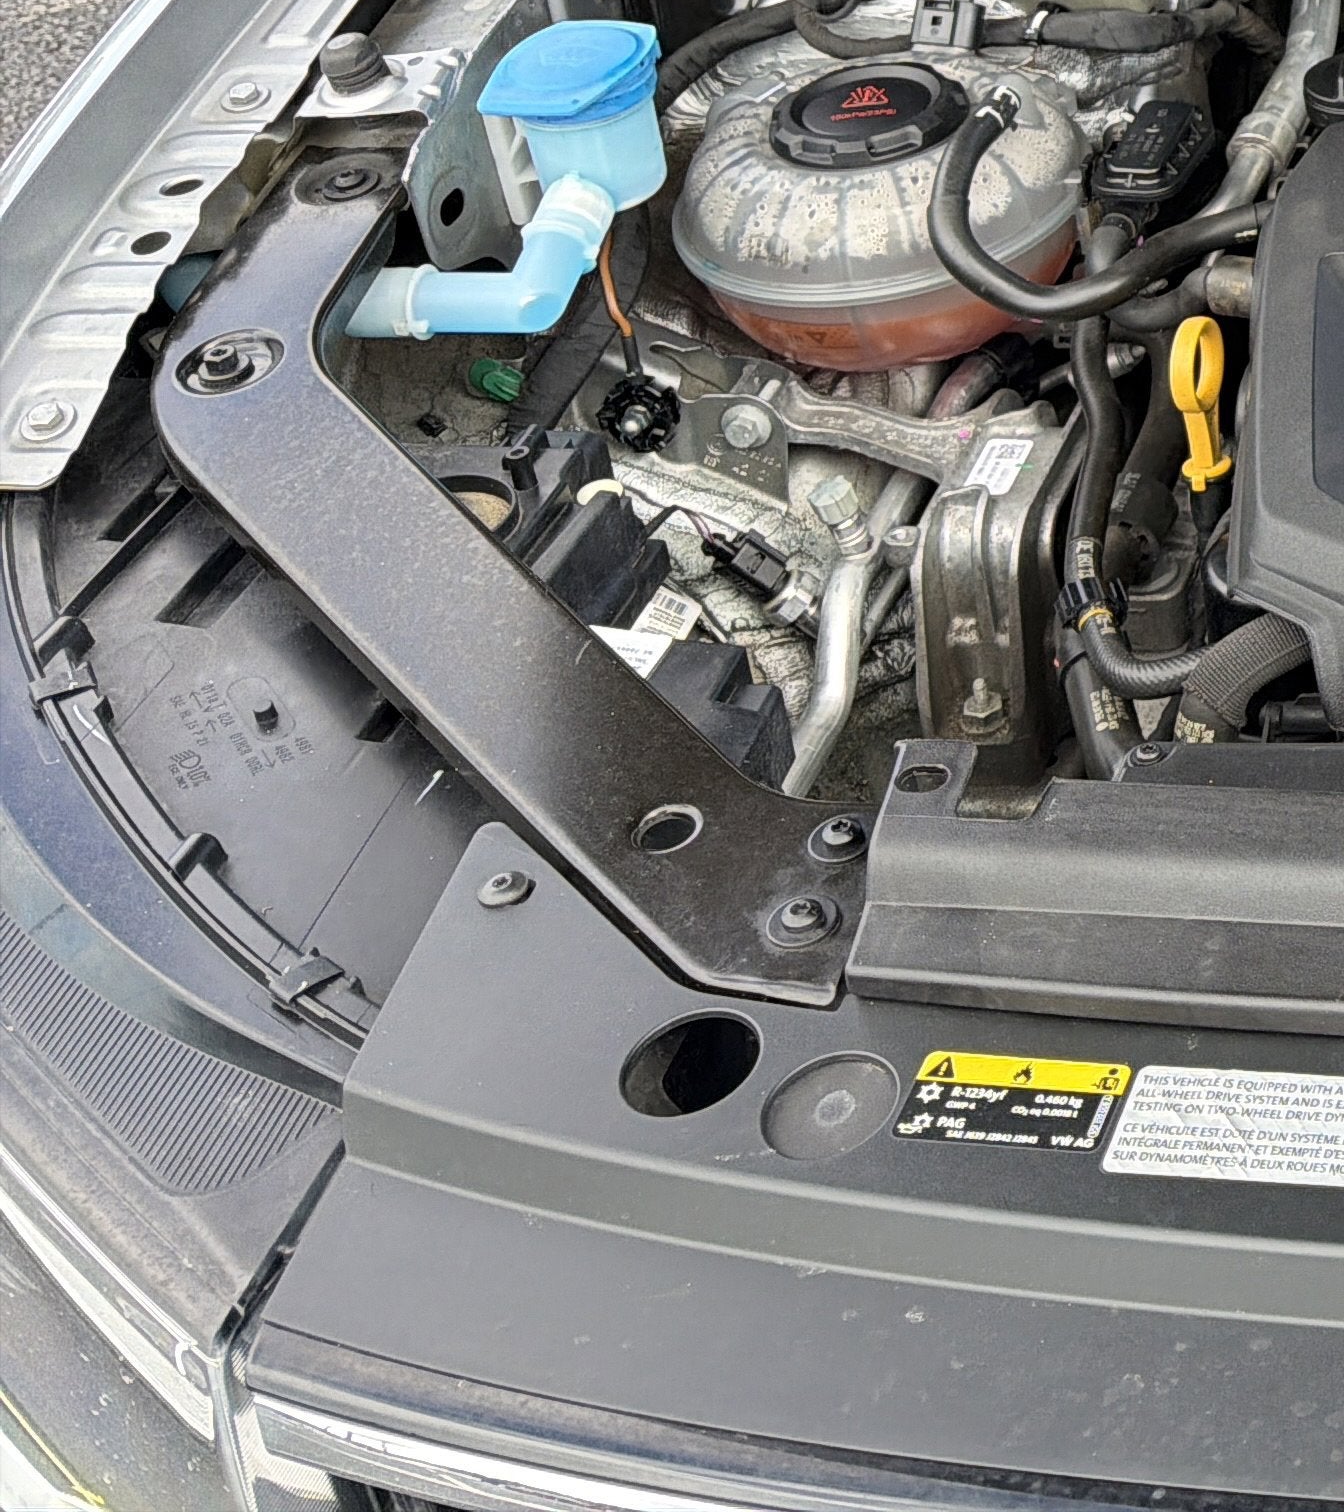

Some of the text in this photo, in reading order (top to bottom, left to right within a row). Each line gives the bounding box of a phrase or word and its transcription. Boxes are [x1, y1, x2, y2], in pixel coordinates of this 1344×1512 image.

[1143, 1074, 1169, 1086] THIS
[1172, 1076, 1220, 1089] VEHICLE
[1223, 1079, 1234, 1090] IS
[1237, 1079, 1299, 1093] EQUIPPED
[1301, 1083, 1332, 1095] WITH
[1334, 1085, 1344, 1096] A
[950, 1087, 1009, 1103] R-1234yf
[1069, 1096, 1084, 1109] kg
[1136, 1088, 1202, 1102] ALL-WHEEL
[1206, 1092, 1244, 1105] DRIVE
[1245, 1094, 1288, 1107] SYSTEM
[1296, 1097, 1320, 1109] AND
[1323, 1098, 1332, 1109] IS
[936, 1116, 966, 1128] PAG
[1133, 1101, 1182, 1114] TESTING
[1184, 1104, 1204, 1116] ON
[1208, 1105, 1283, 1120] TWO-WHEEL
[1286, 1110, 1322, 1122] DRIVE
[1050, 1136, 1094, 1148] VW AG
[1123, 1122, 1141, 1134] CE
[1143, 1121, 1198, 1137] VÉHICULE
[1200, 1127, 1220, 1139] EST
[1223, 1126, 1254, 1141] DOTÉ
[1257, 1130, 1288, 1143] D'UN
[1290, 1130, 1344, 1146] SYSTÈME
[1117, 1134, 1180, 1151] INTÉGRALE
[1270, 1143, 1322, 1159] EXEMPTÉ
[1111, 1150, 1137, 1162] SUR
[1138, 1149, 1237, 1168] DYNAMOMÈTRES
[1238, 1155, 1248, 1169] À
[1250, 1158, 1283, 1171] DEUX
[1286, 1160, 1326, 1173] ROUES
